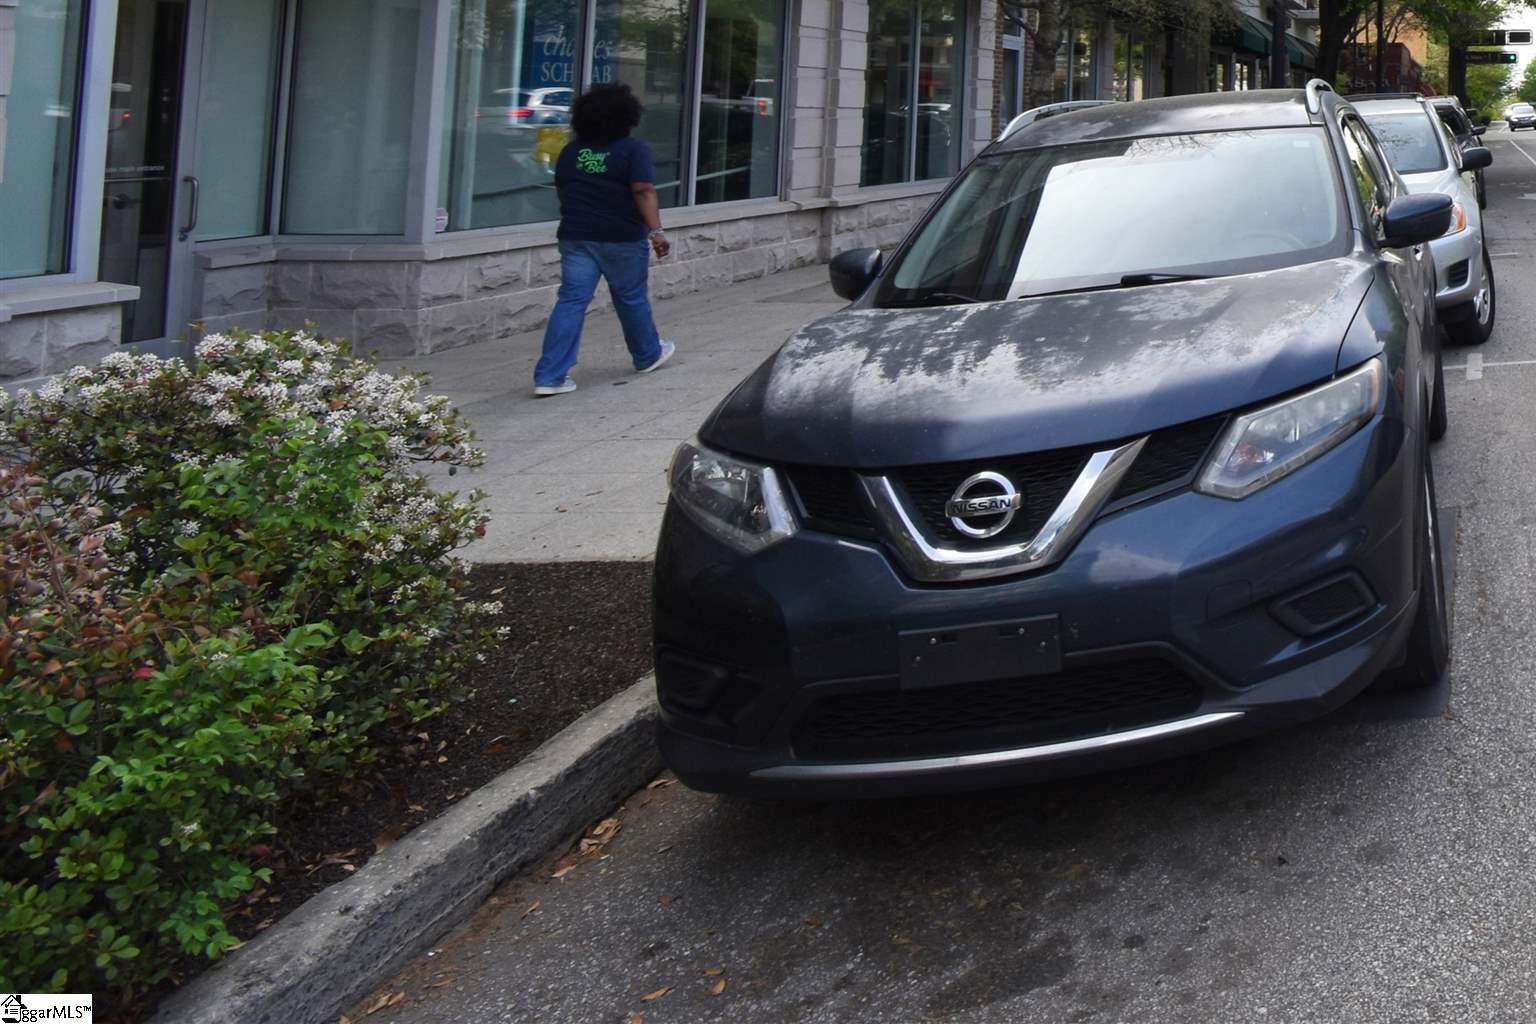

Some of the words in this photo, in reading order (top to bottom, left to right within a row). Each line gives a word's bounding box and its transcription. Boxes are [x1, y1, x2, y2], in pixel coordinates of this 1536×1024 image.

[543, 25, 614, 59] chaes
[540, 62, 612, 84] SCHAB
[577, 148, 608, 165] Busy
[951, 498, 1012, 514] NISSAN
